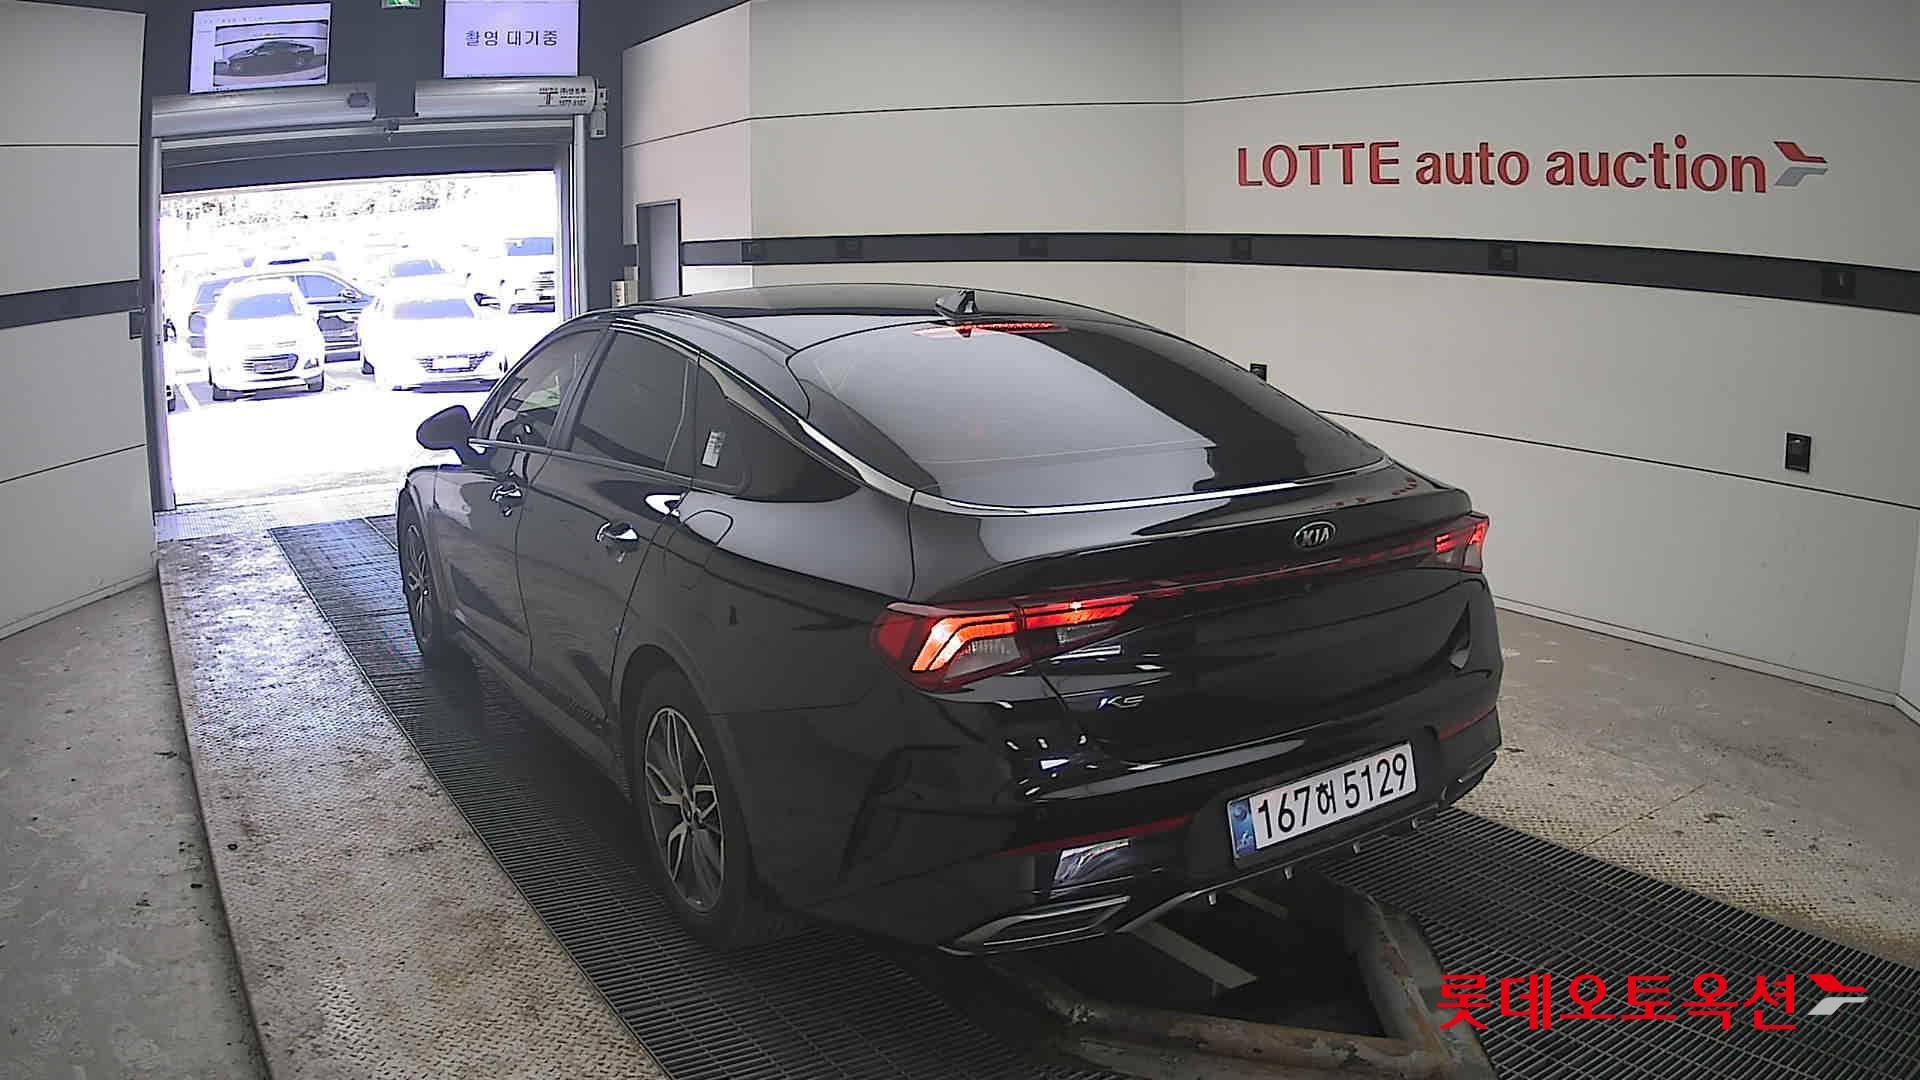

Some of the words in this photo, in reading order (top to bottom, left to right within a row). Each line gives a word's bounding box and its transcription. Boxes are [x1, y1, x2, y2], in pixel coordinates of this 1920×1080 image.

[507, 30, 557, 46] 대기중
[1237, 141, 1400, 187] LOTTE
[1416, 142, 1529, 185] auto
[1546, 134, 1767, 193] auction
[1258, 780, 1337, 839] 167허
[1344, 753, 1407, 808] 5129
